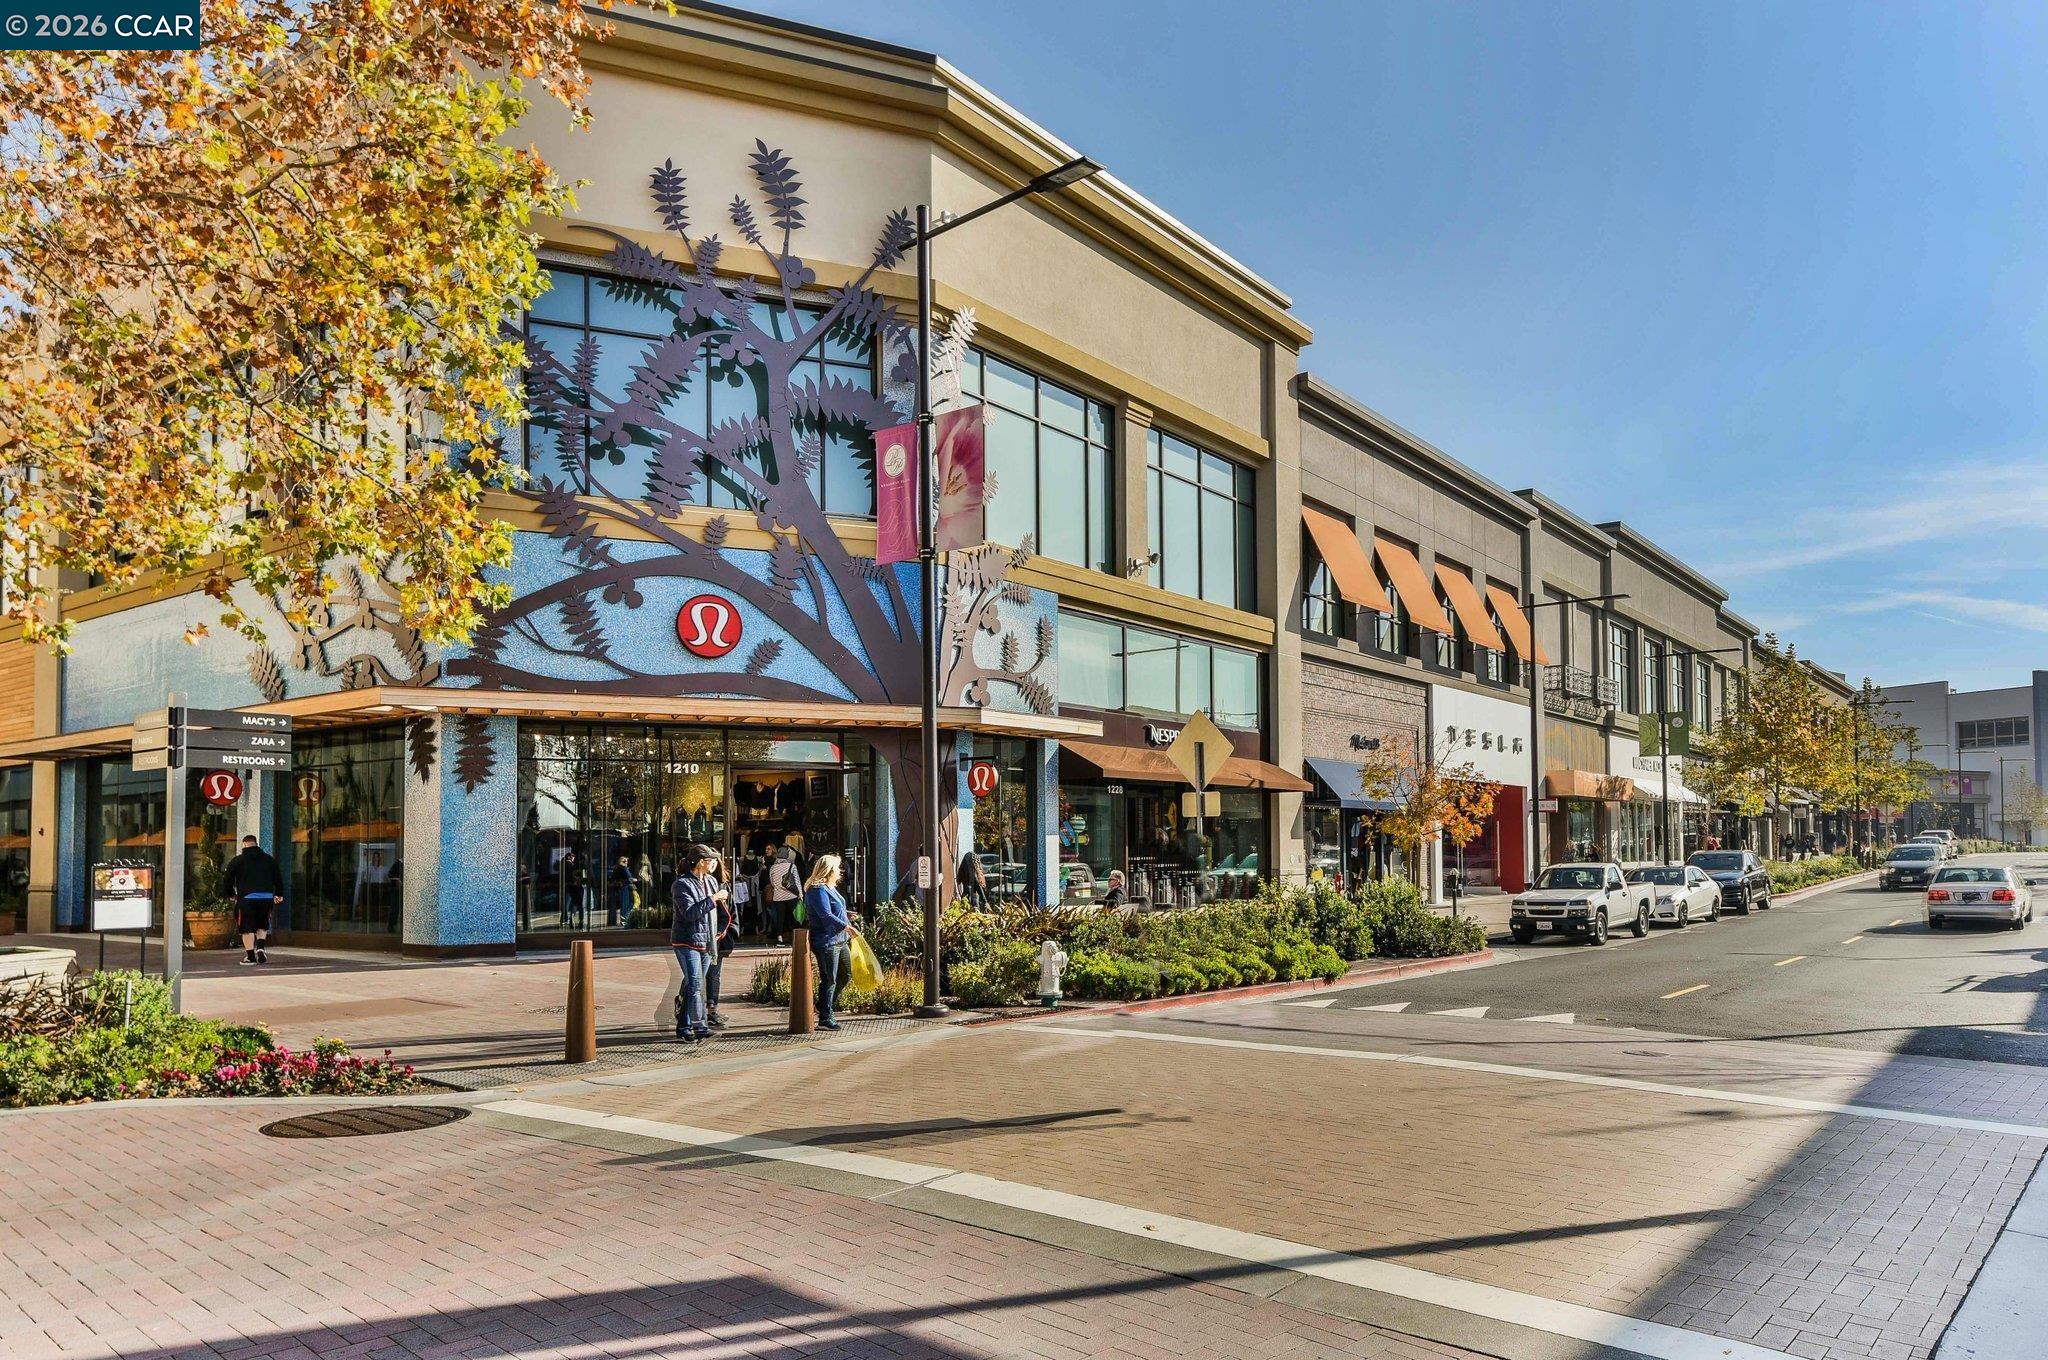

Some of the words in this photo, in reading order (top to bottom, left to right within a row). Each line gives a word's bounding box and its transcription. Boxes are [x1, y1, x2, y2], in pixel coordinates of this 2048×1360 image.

[242, 716, 276, 726] MACY'S
[250, 736, 275, 746] ZARA
[1446, 725, 1523, 755] TESLA
[222, 755, 276, 766] RESTROOMS
[664, 762, 700, 774] 1210
[1106, 784, 1124, 794] 1228
